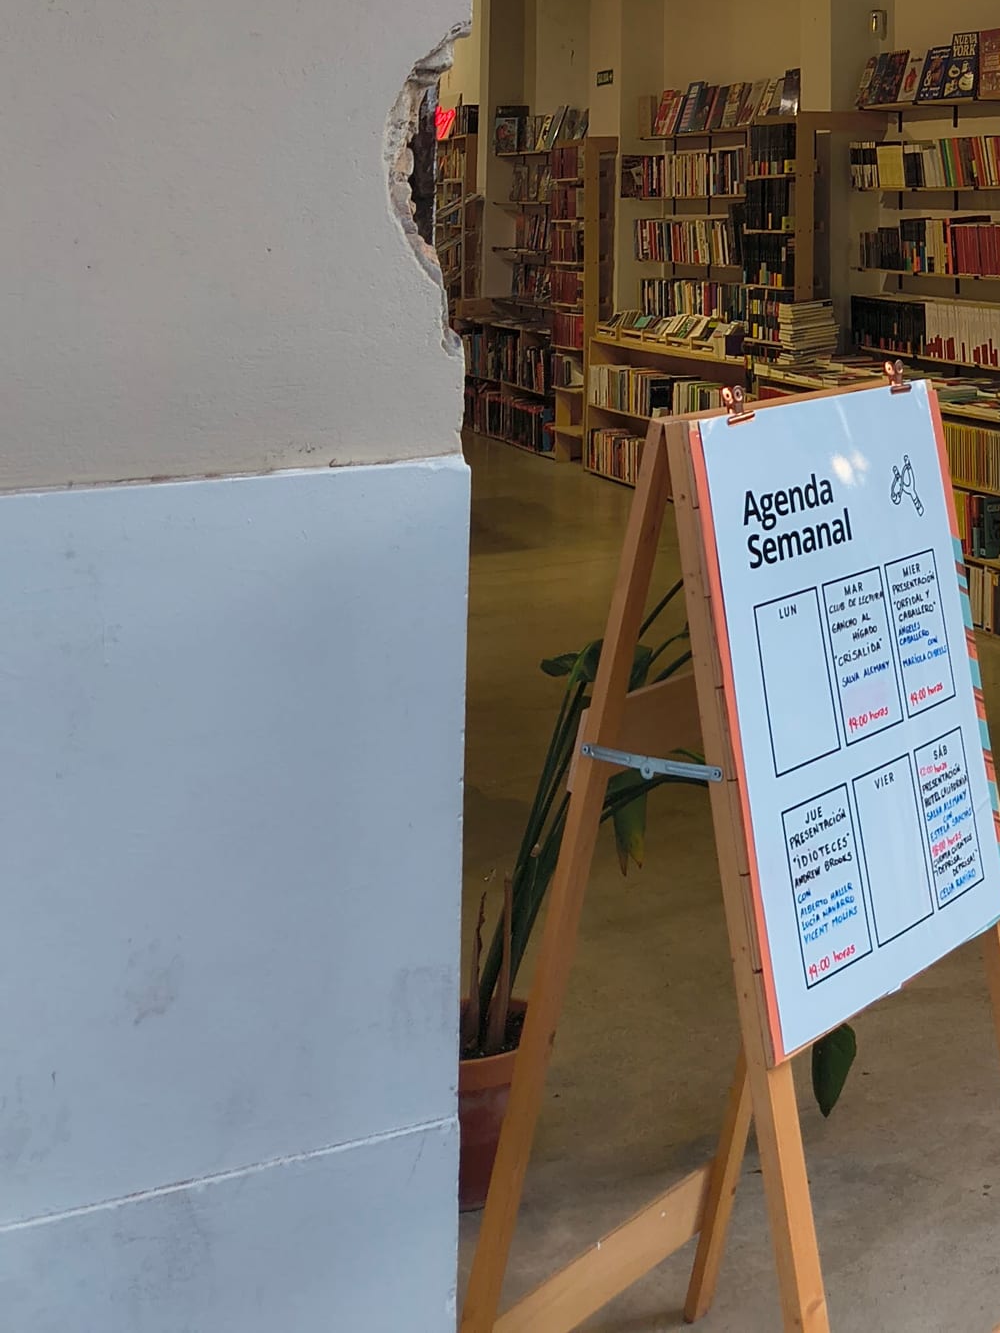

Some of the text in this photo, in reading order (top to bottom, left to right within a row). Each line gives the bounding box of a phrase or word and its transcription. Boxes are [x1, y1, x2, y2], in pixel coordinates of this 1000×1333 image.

[953, 33, 978, 46] NUEVA
[952, 44, 977, 58] YORK
[743, 473, 834, 531] Agenda
[747, 508, 853, 569] Semanal
[902, 563, 921, 577] MIER
[844, 582, 863, 596] MAR
[925, 589, 930, 599] Y
[829, 591, 884, 614] CLUB DE LECTURA
[778, 603, 798, 620] LUN
[862, 613, 871, 623] AL
[842, 674, 860, 688] SALVA
[933, 744, 948, 760] SÁB
[874, 771, 895, 790] VIER
[805, 806, 823, 824] JUE
[794, 851, 852, 889] ANDREW BROOKS
[797, 888, 811, 904] CON
[800, 898, 828, 918] ALBERTO
[804, 922, 829, 944] VICENT
[809, 944, 855, 981] 19:00 horas
